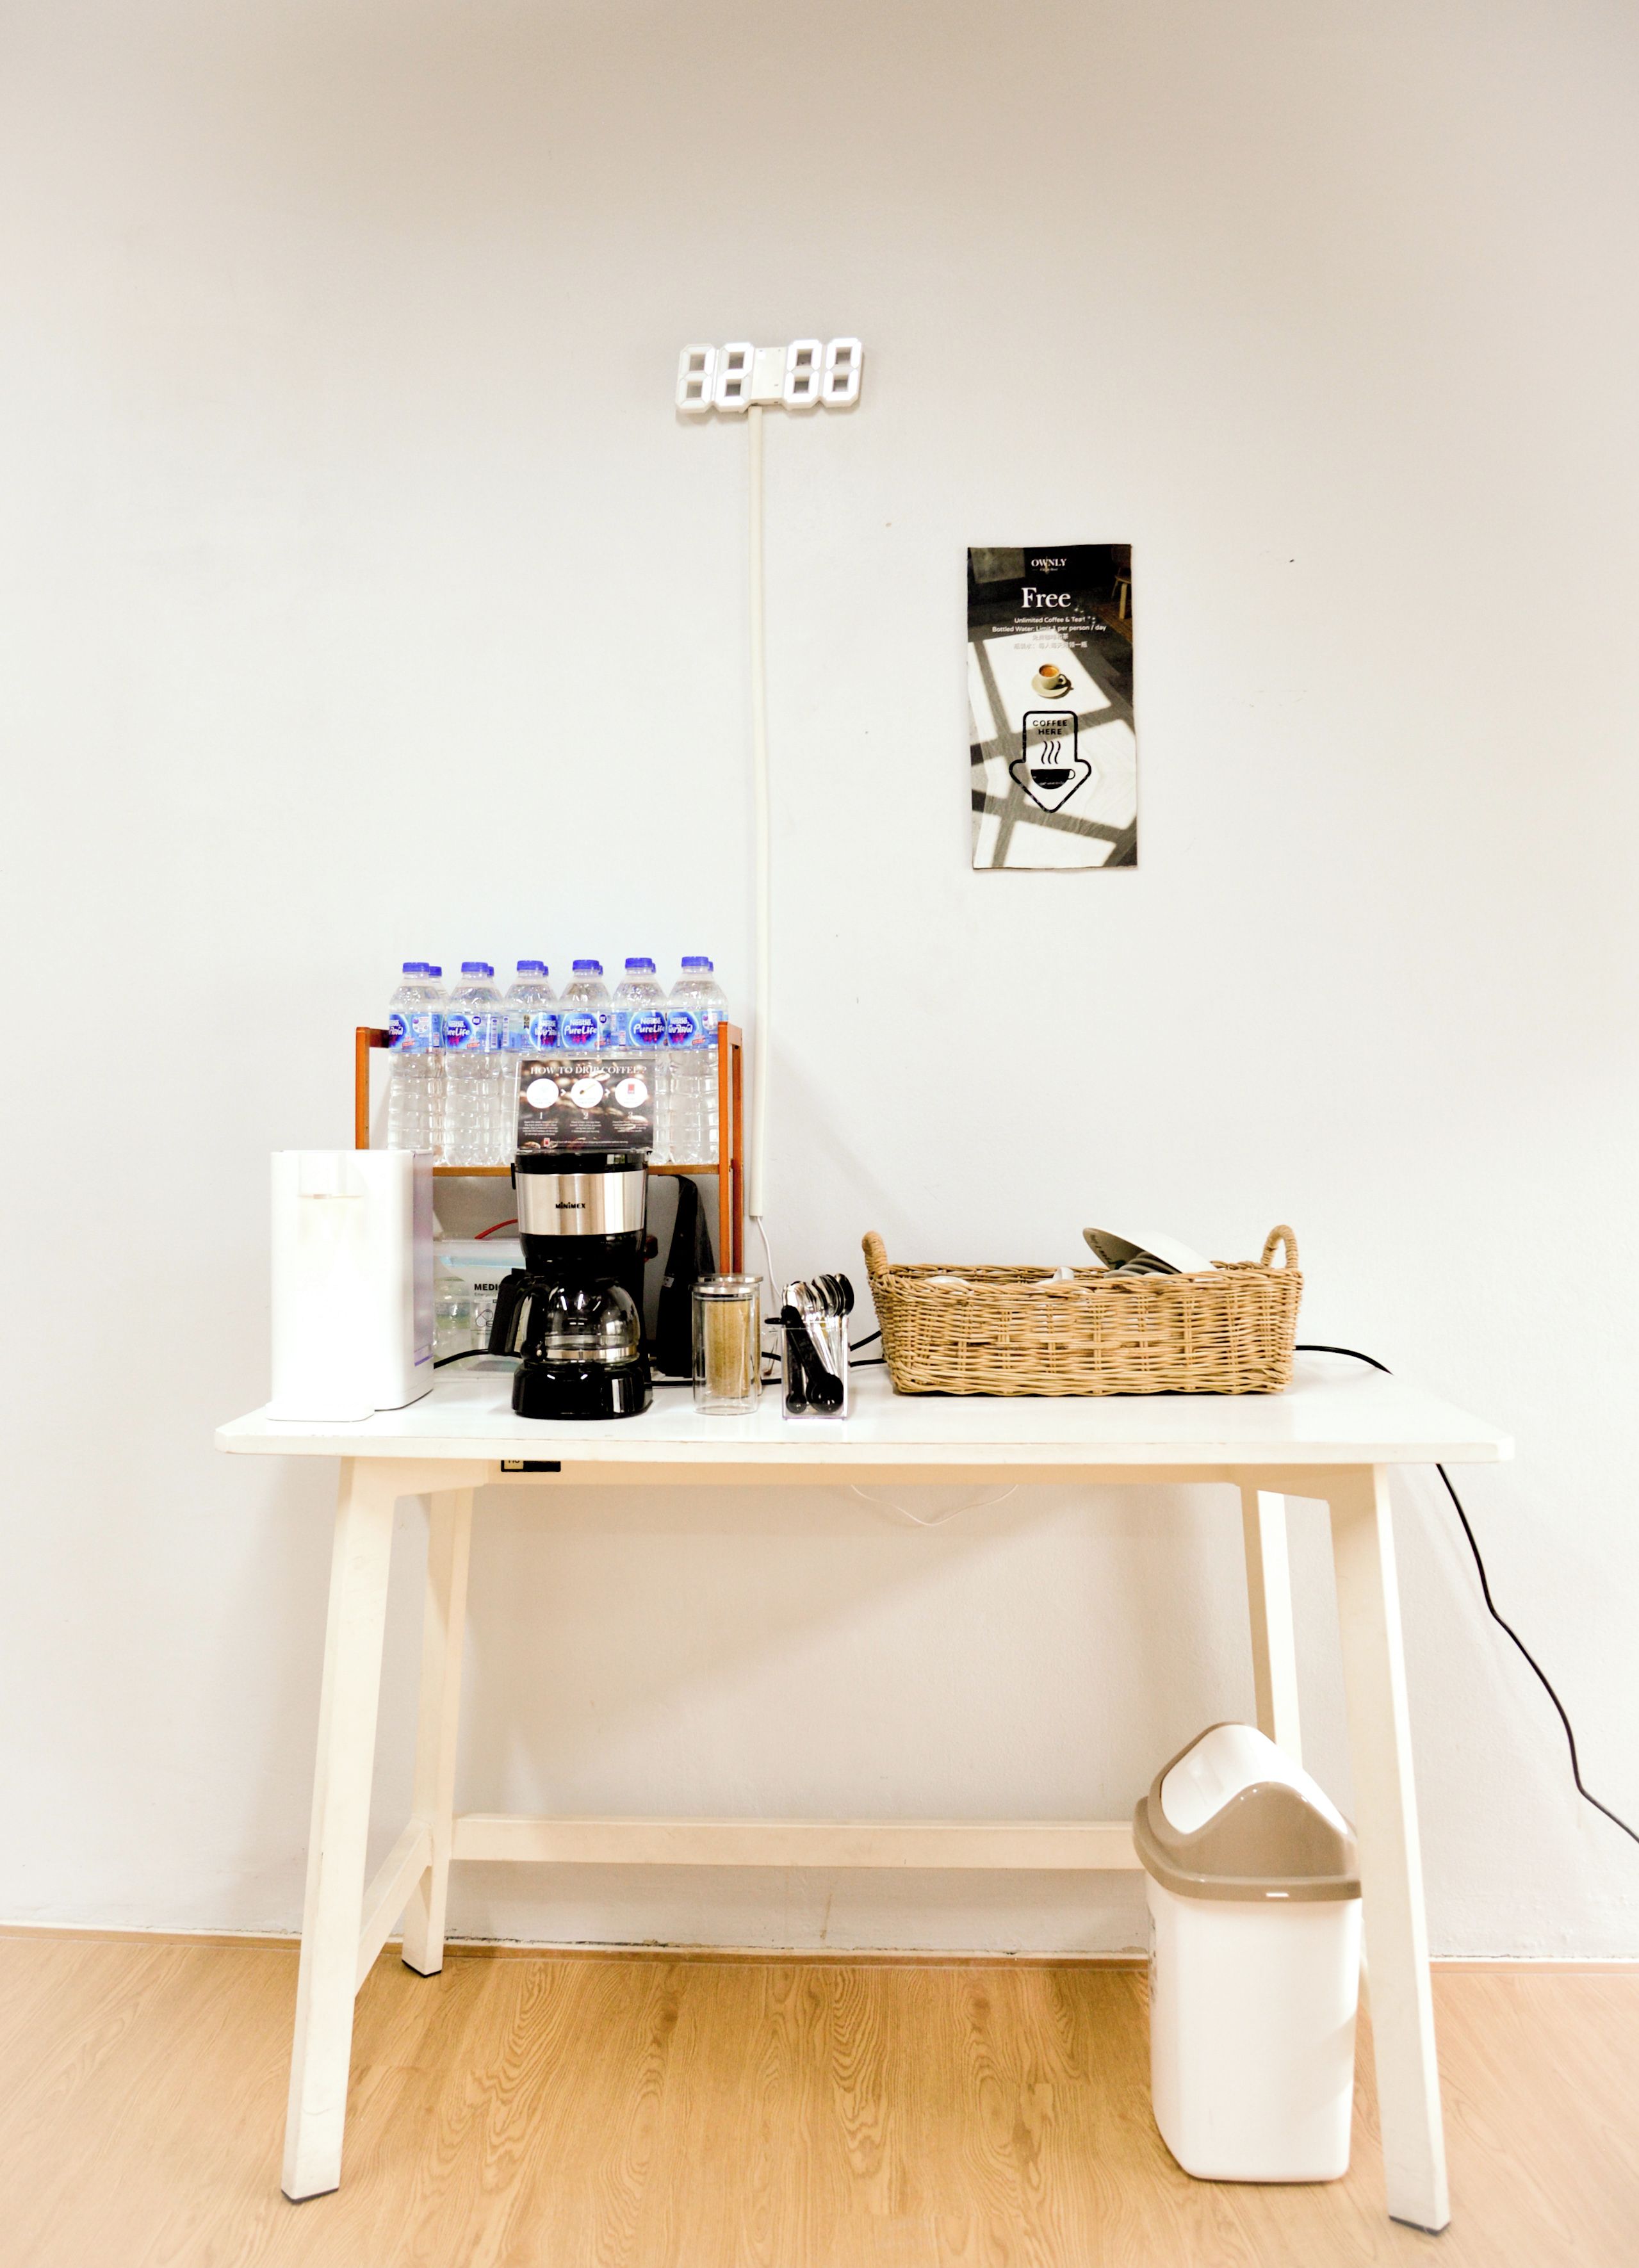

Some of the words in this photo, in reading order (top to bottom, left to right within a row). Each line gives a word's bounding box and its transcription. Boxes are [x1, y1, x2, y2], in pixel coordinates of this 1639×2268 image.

[1031, 559, 1066, 567] OWNLY
[1021, 587, 1072, 608] Free
[530, 1066, 555, 1075] HOW
[559, 1066, 573, 1074] TO
[575, 1066, 599, 1074] DRIP
[583, 1111, 589, 1120] 2
